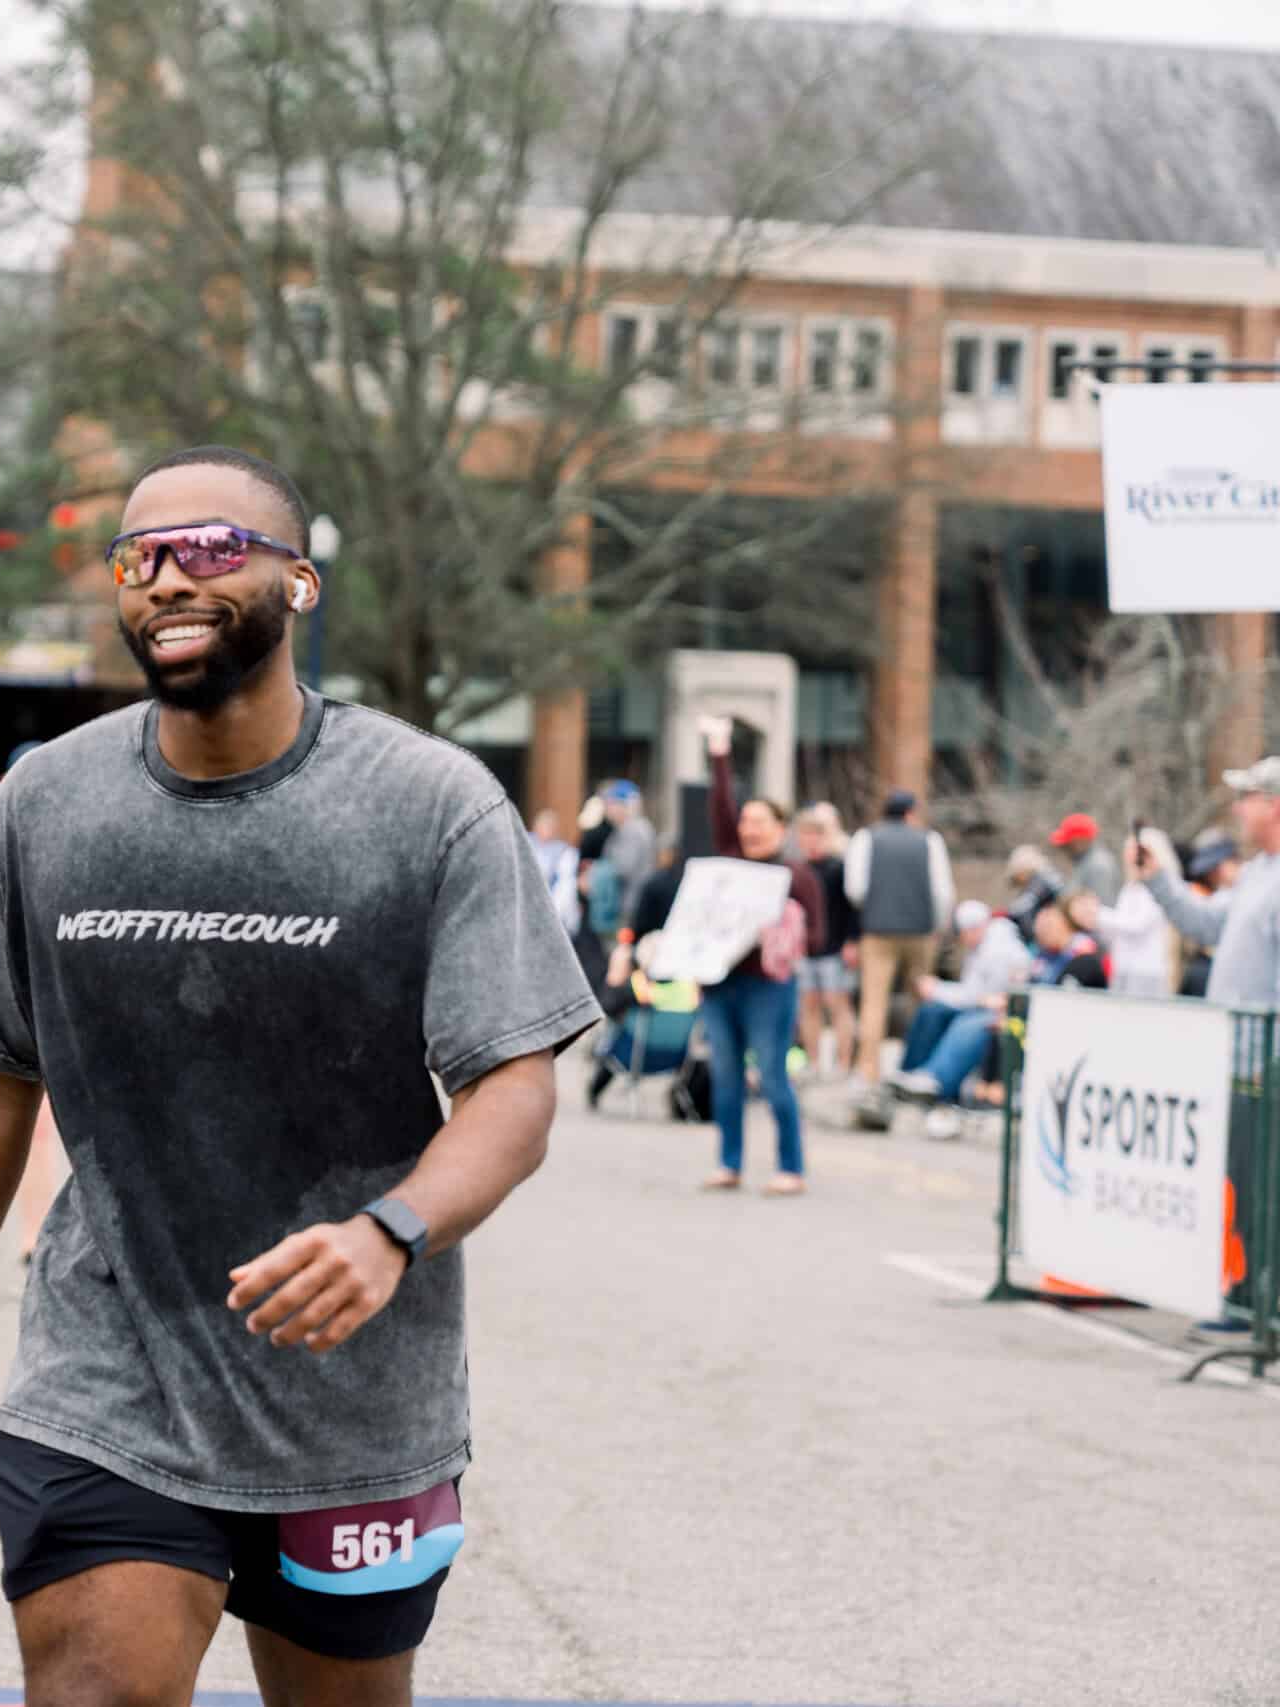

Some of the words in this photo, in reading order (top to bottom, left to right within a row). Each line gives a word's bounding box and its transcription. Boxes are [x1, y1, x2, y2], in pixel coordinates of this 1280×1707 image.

[1126, 480, 1220, 524] River
[1229, 478, 1280, 513] Cit
[56, 909, 340, 947] WEOFFTHECOUCH
[1079, 1083, 1199, 1168] SPORTS
[1094, 1167, 1199, 1232] BACKERS
[331, 1517, 416, 1569] 561
